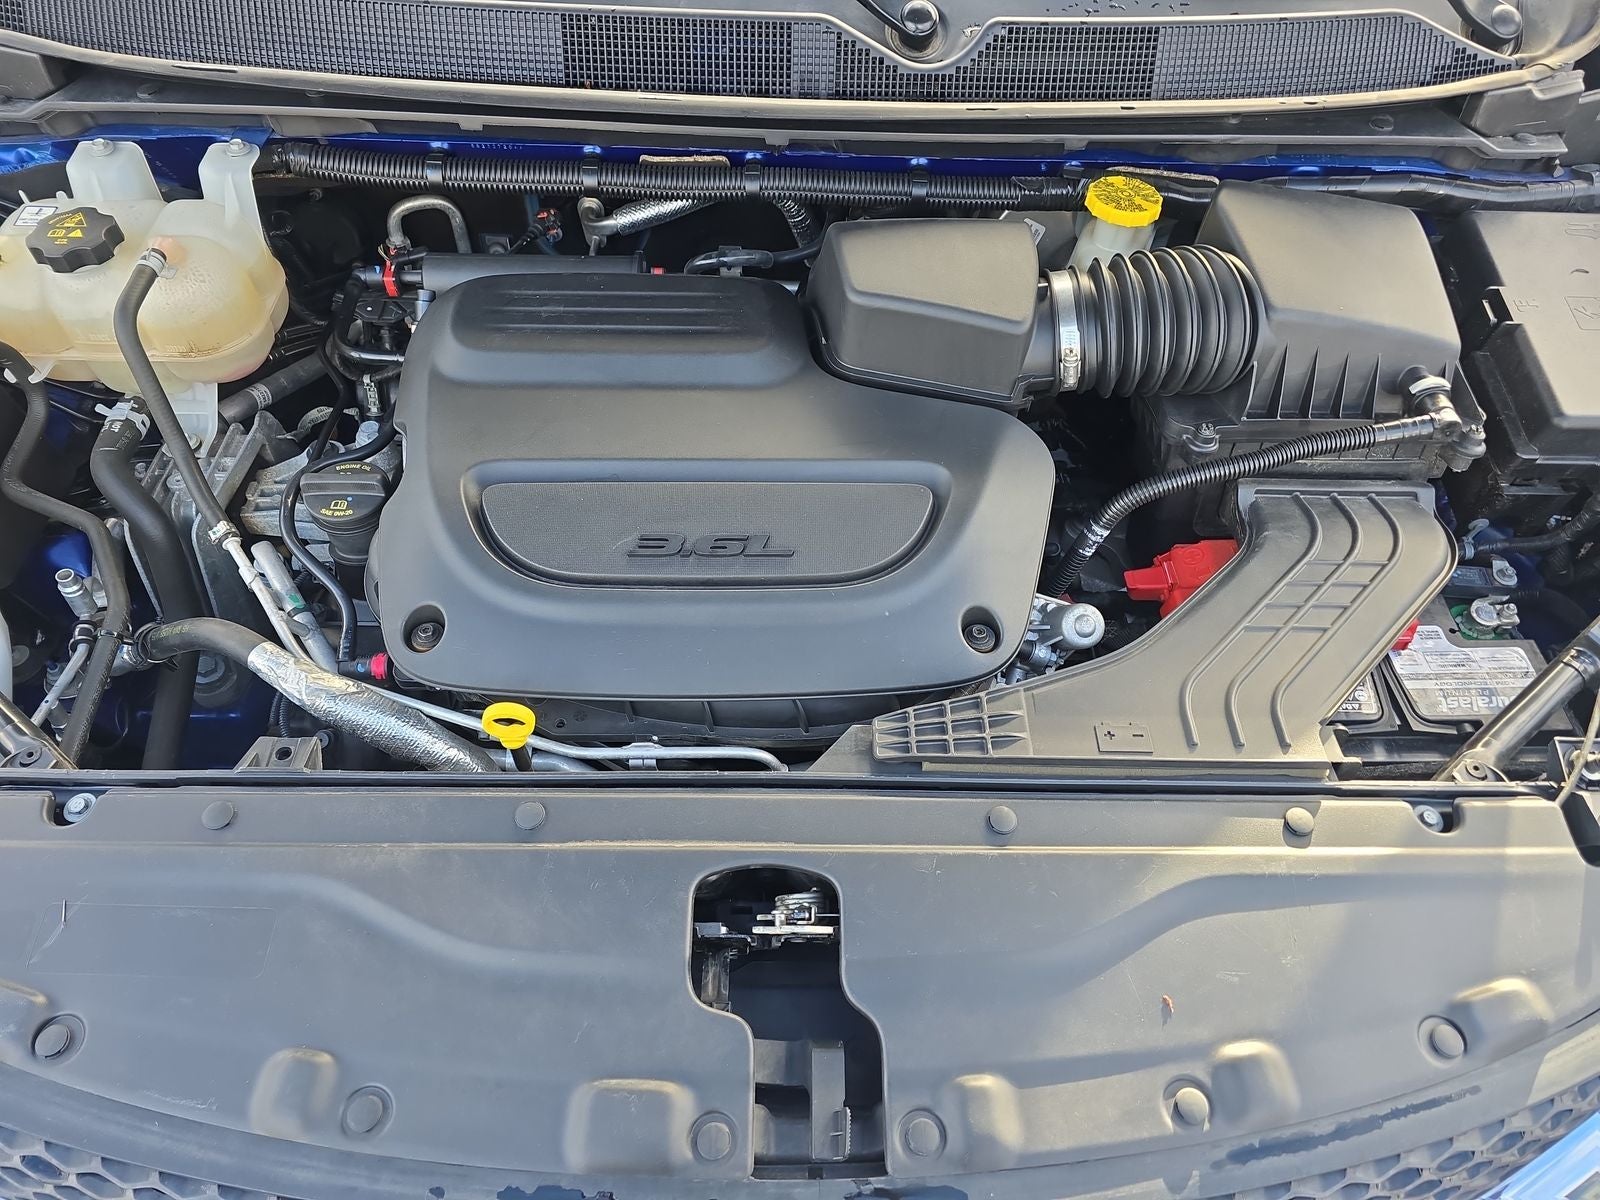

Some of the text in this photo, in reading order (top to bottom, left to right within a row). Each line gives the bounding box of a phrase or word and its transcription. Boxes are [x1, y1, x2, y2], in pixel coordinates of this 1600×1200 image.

[320, 508, 354, 517] SAE 0W-20
[627, 532, 795, 558] 3.6L
[1434, 688, 1489, 696] PLATINUM
